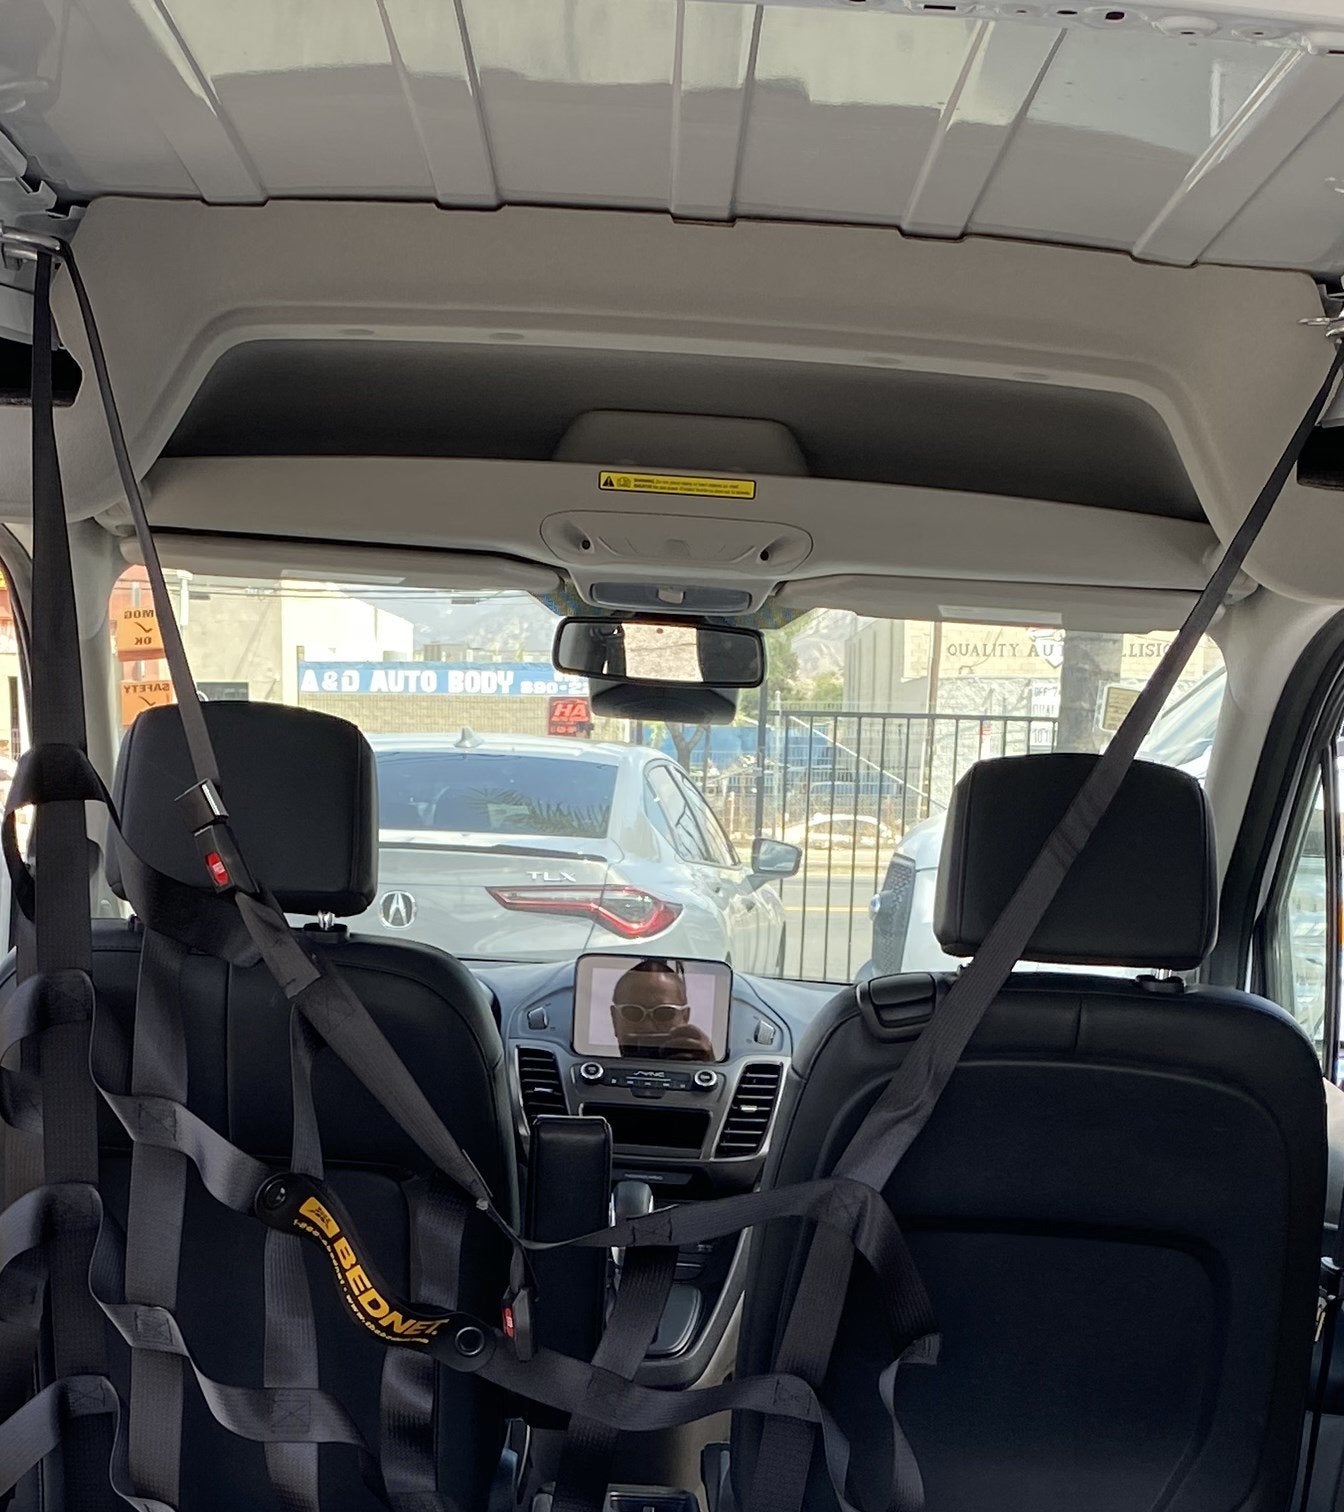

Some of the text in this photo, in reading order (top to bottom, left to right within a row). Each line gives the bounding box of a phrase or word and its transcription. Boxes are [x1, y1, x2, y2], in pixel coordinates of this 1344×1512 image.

[947, 643, 1019, 658] QUALITY
[1027, 643, 1057, 658] AU
[369, 670, 438, 693] AUTO
[447, 670, 514, 694] BODY
[526, 871, 577, 882] TLX
